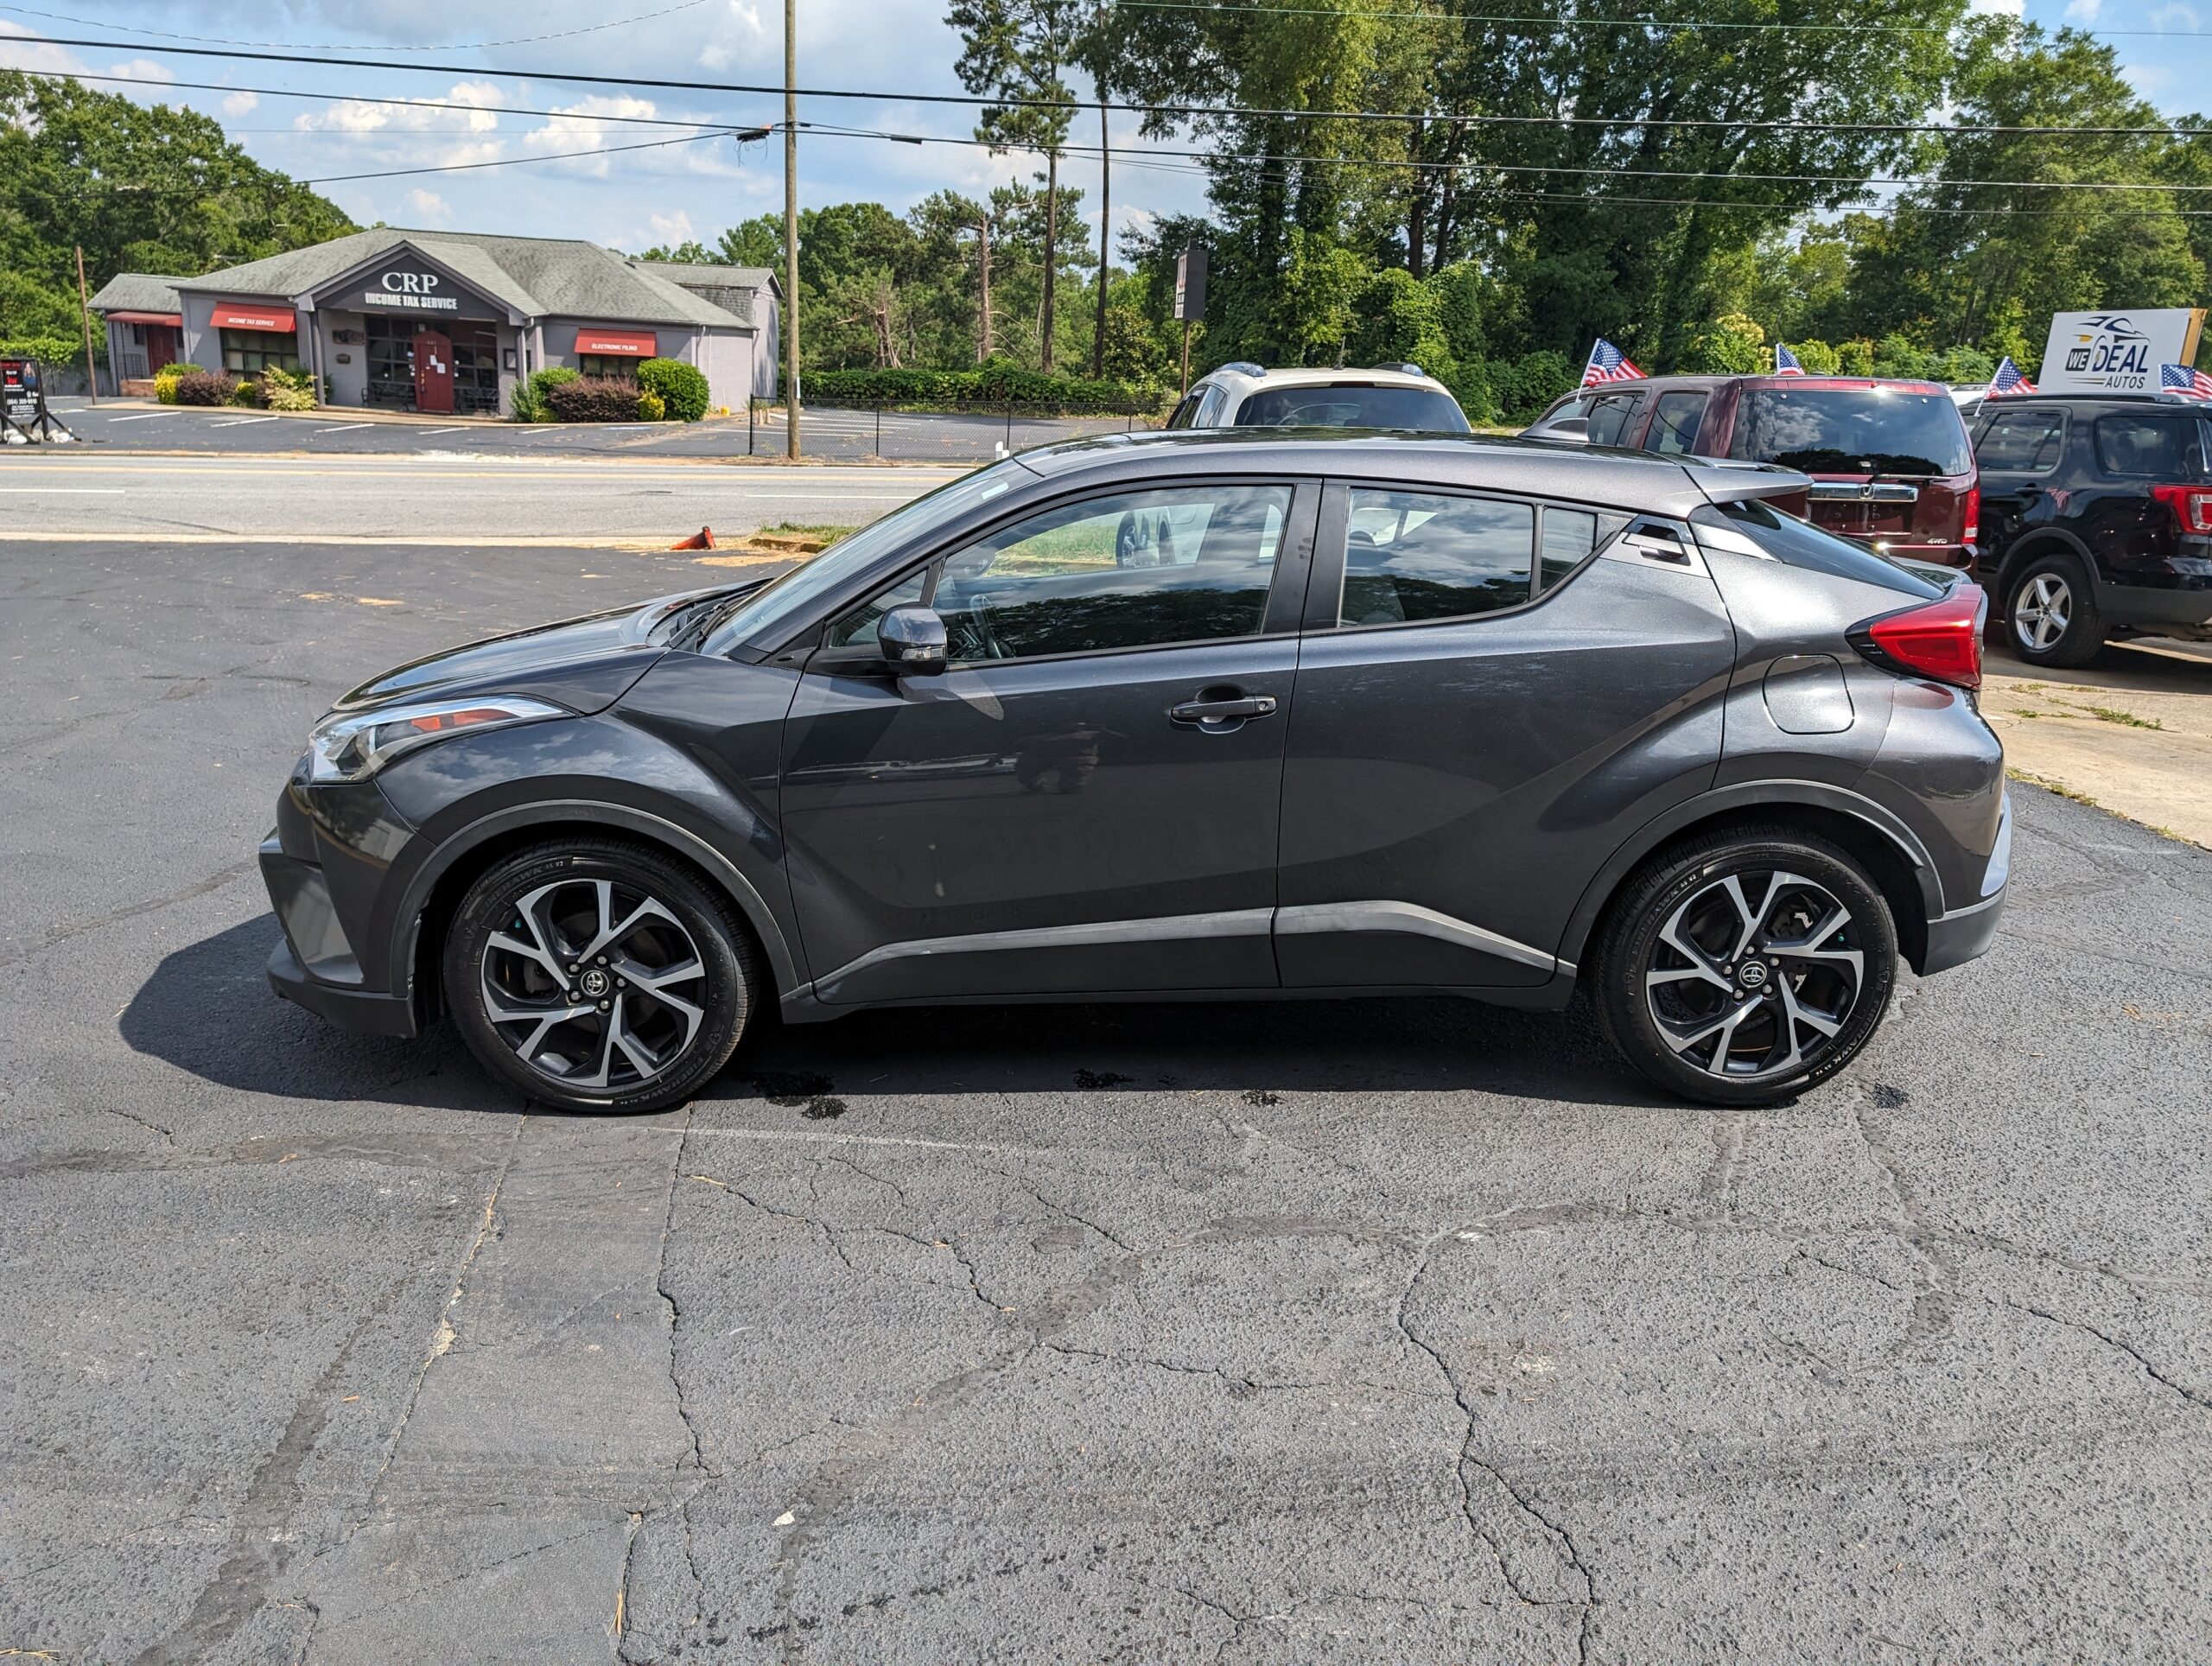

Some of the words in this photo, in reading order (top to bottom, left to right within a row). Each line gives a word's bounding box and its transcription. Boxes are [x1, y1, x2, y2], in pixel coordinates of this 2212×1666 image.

[381, 271, 439, 294] CRP
[365, 292, 402, 307] INCOME
[402, 295, 420, 308] TAX
[420, 296, 458, 309] SERVICE
[2068, 351, 2089, 369] WE
[2092, 345, 2150, 373] DEAL
[2105, 376, 2145, 389] AUTOS
